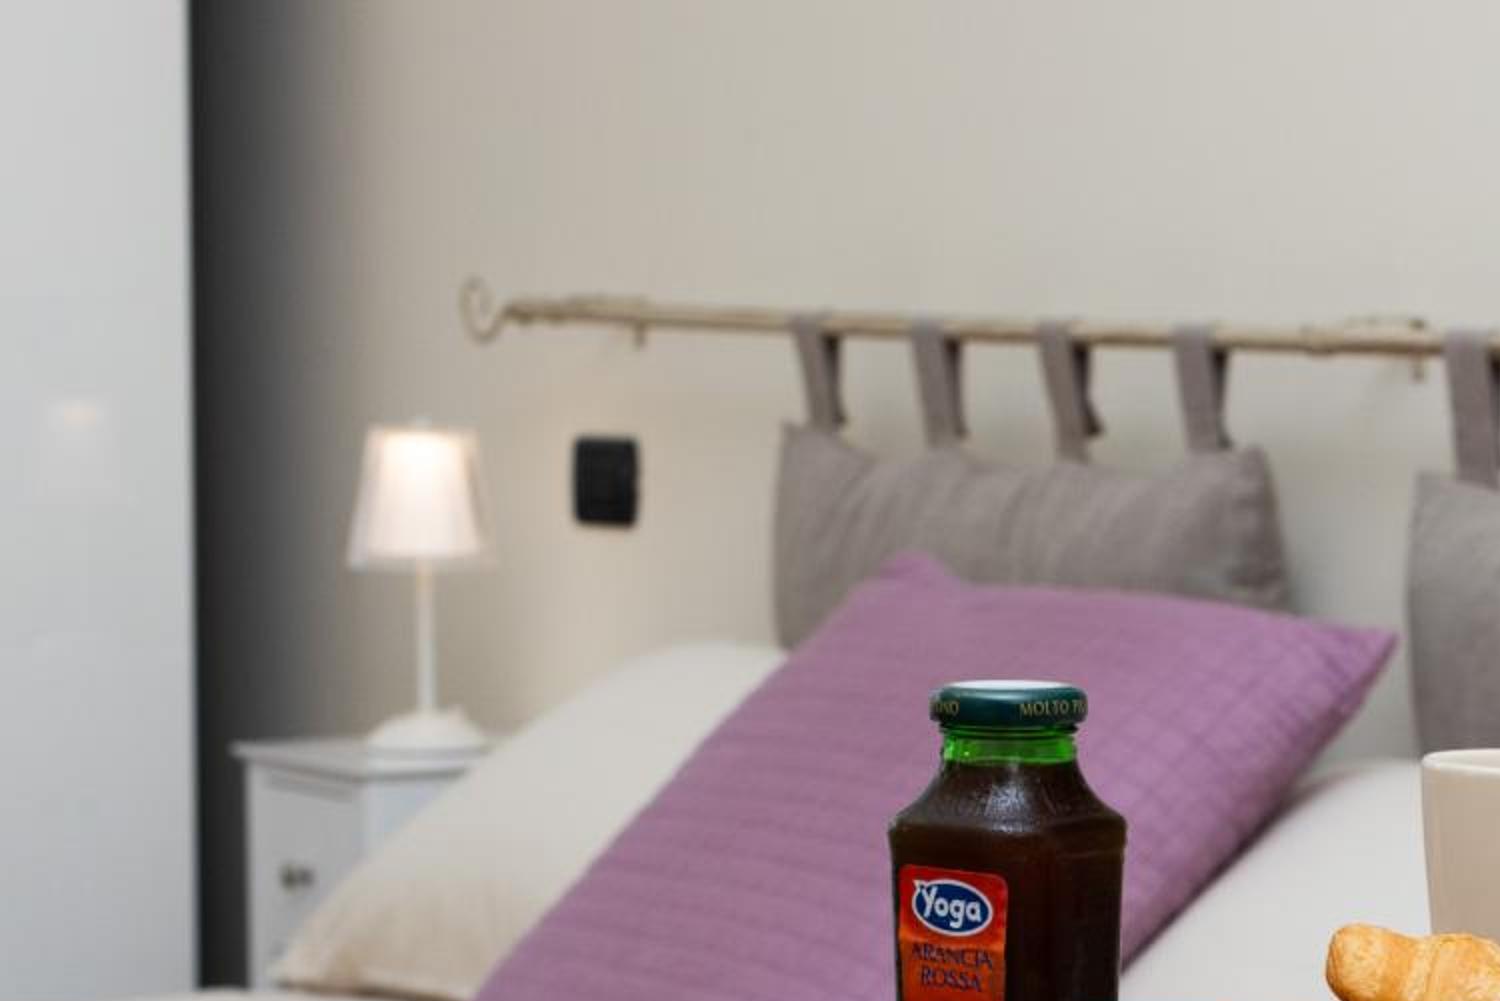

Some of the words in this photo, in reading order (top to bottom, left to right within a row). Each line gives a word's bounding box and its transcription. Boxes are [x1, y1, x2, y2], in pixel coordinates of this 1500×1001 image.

[1020, 700, 1069, 716] MOLTO
[921, 886, 982, 929] Yoga
[912, 943, 993, 970] ARANCIA
[921, 964, 982, 992] ROSSA
